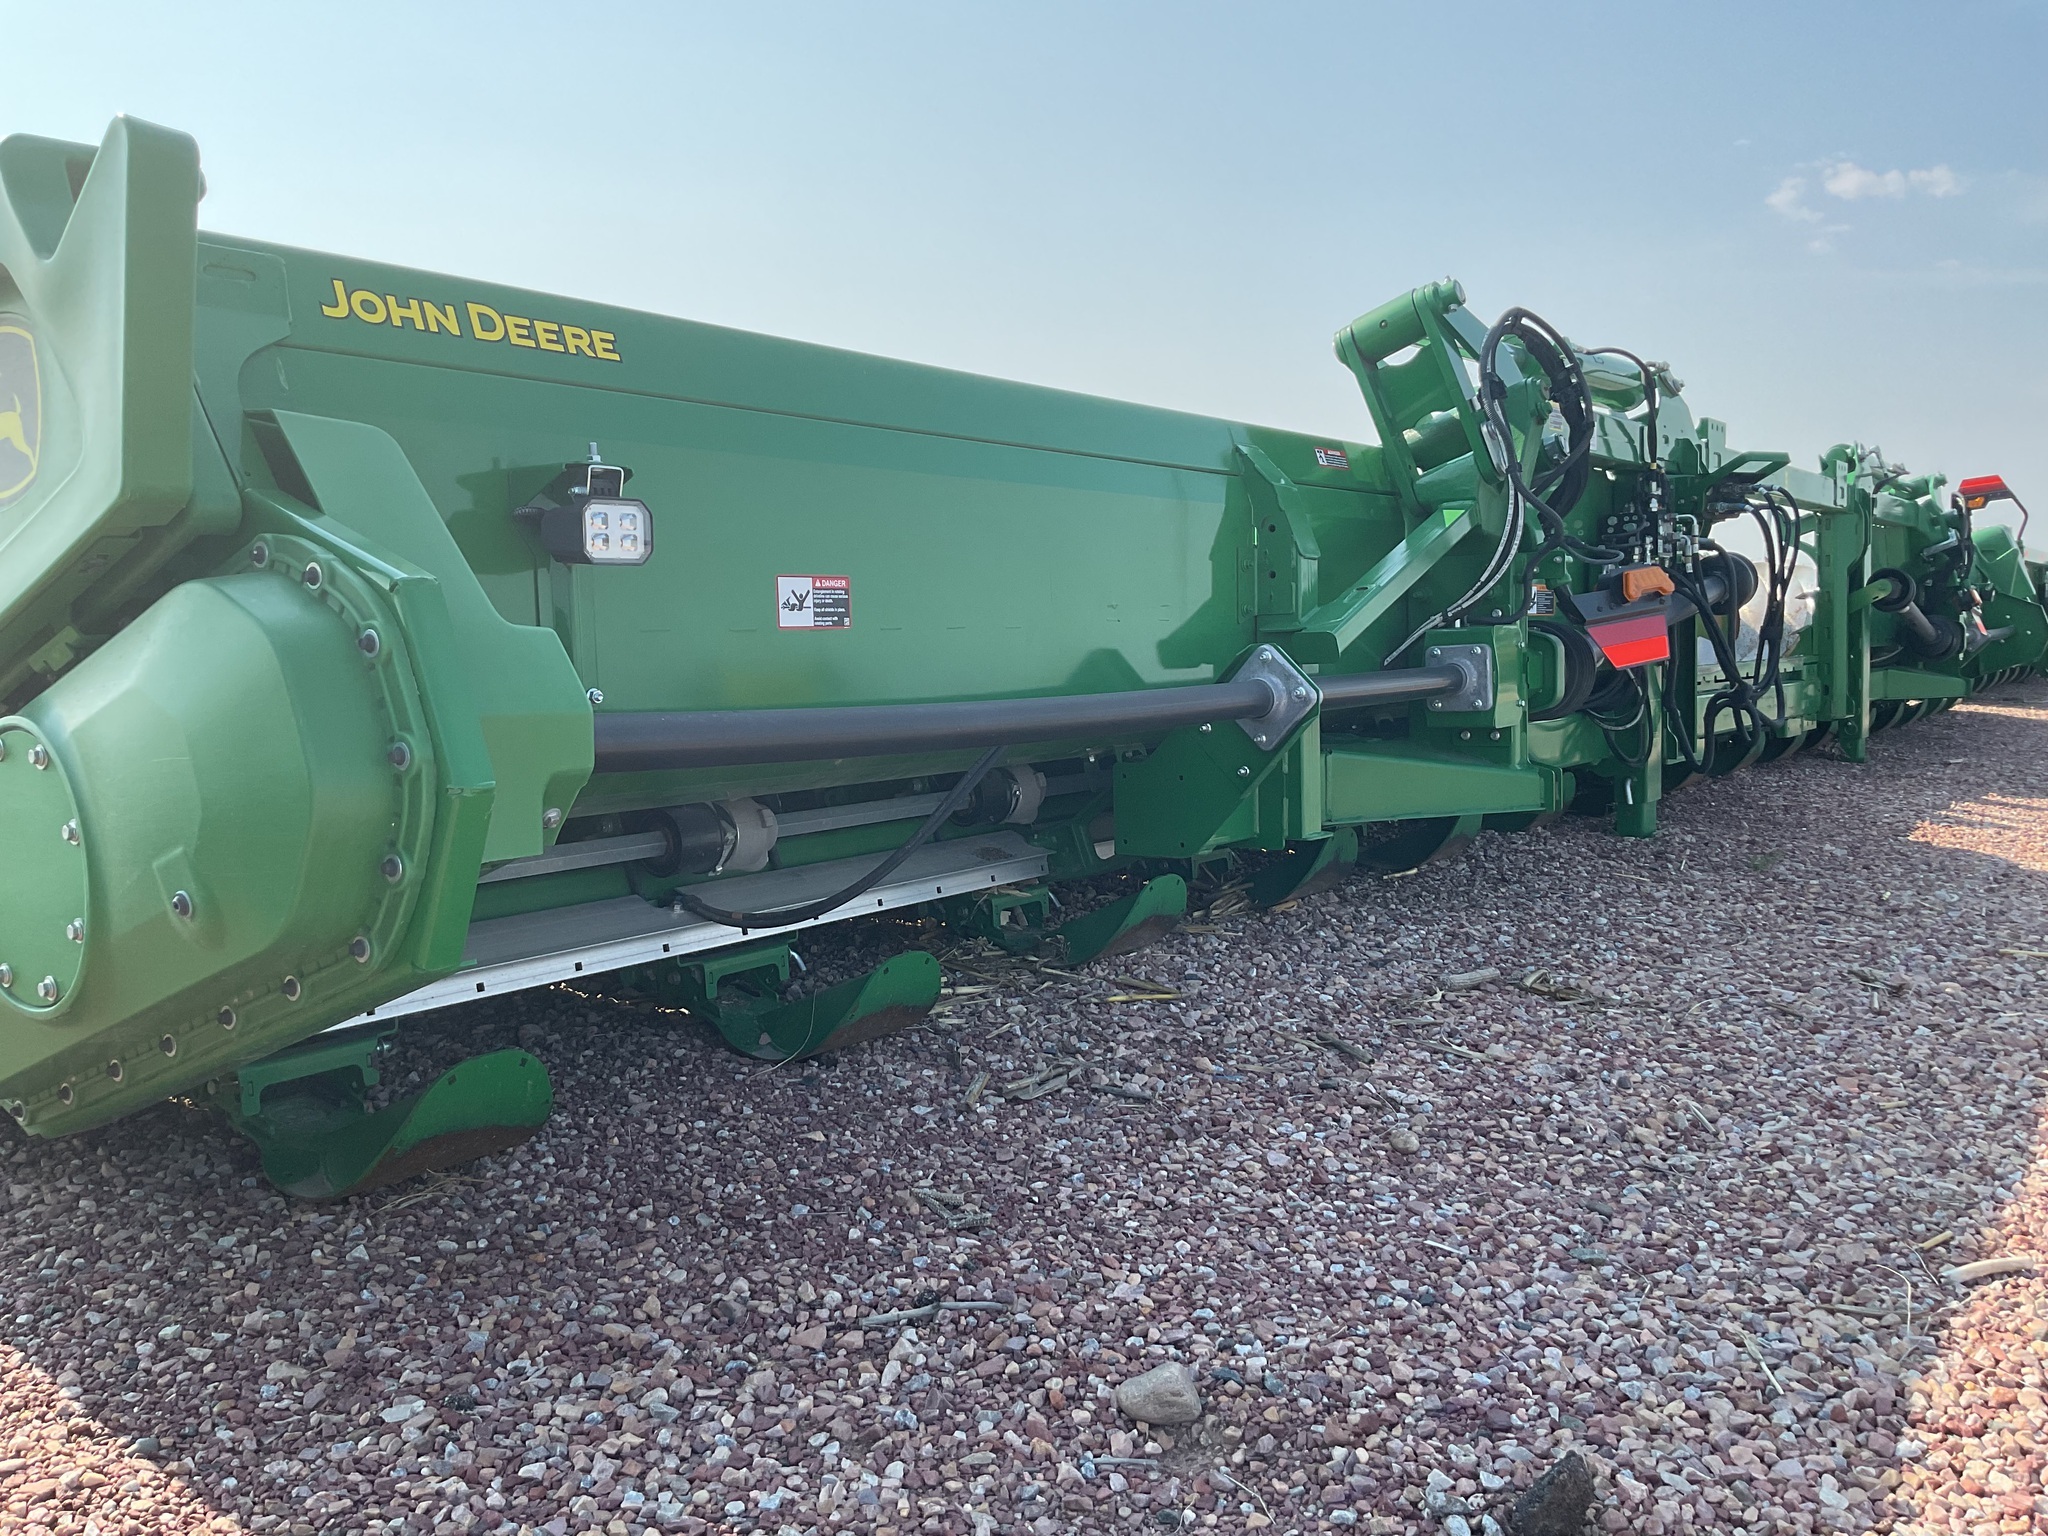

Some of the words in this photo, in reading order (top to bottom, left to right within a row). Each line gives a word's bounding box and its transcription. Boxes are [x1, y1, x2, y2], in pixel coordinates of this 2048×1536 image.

[320, 278, 462, 337] JOHN
[466, 301, 622, 362] DEERE
[821, 579, 846, 587] DANGER
